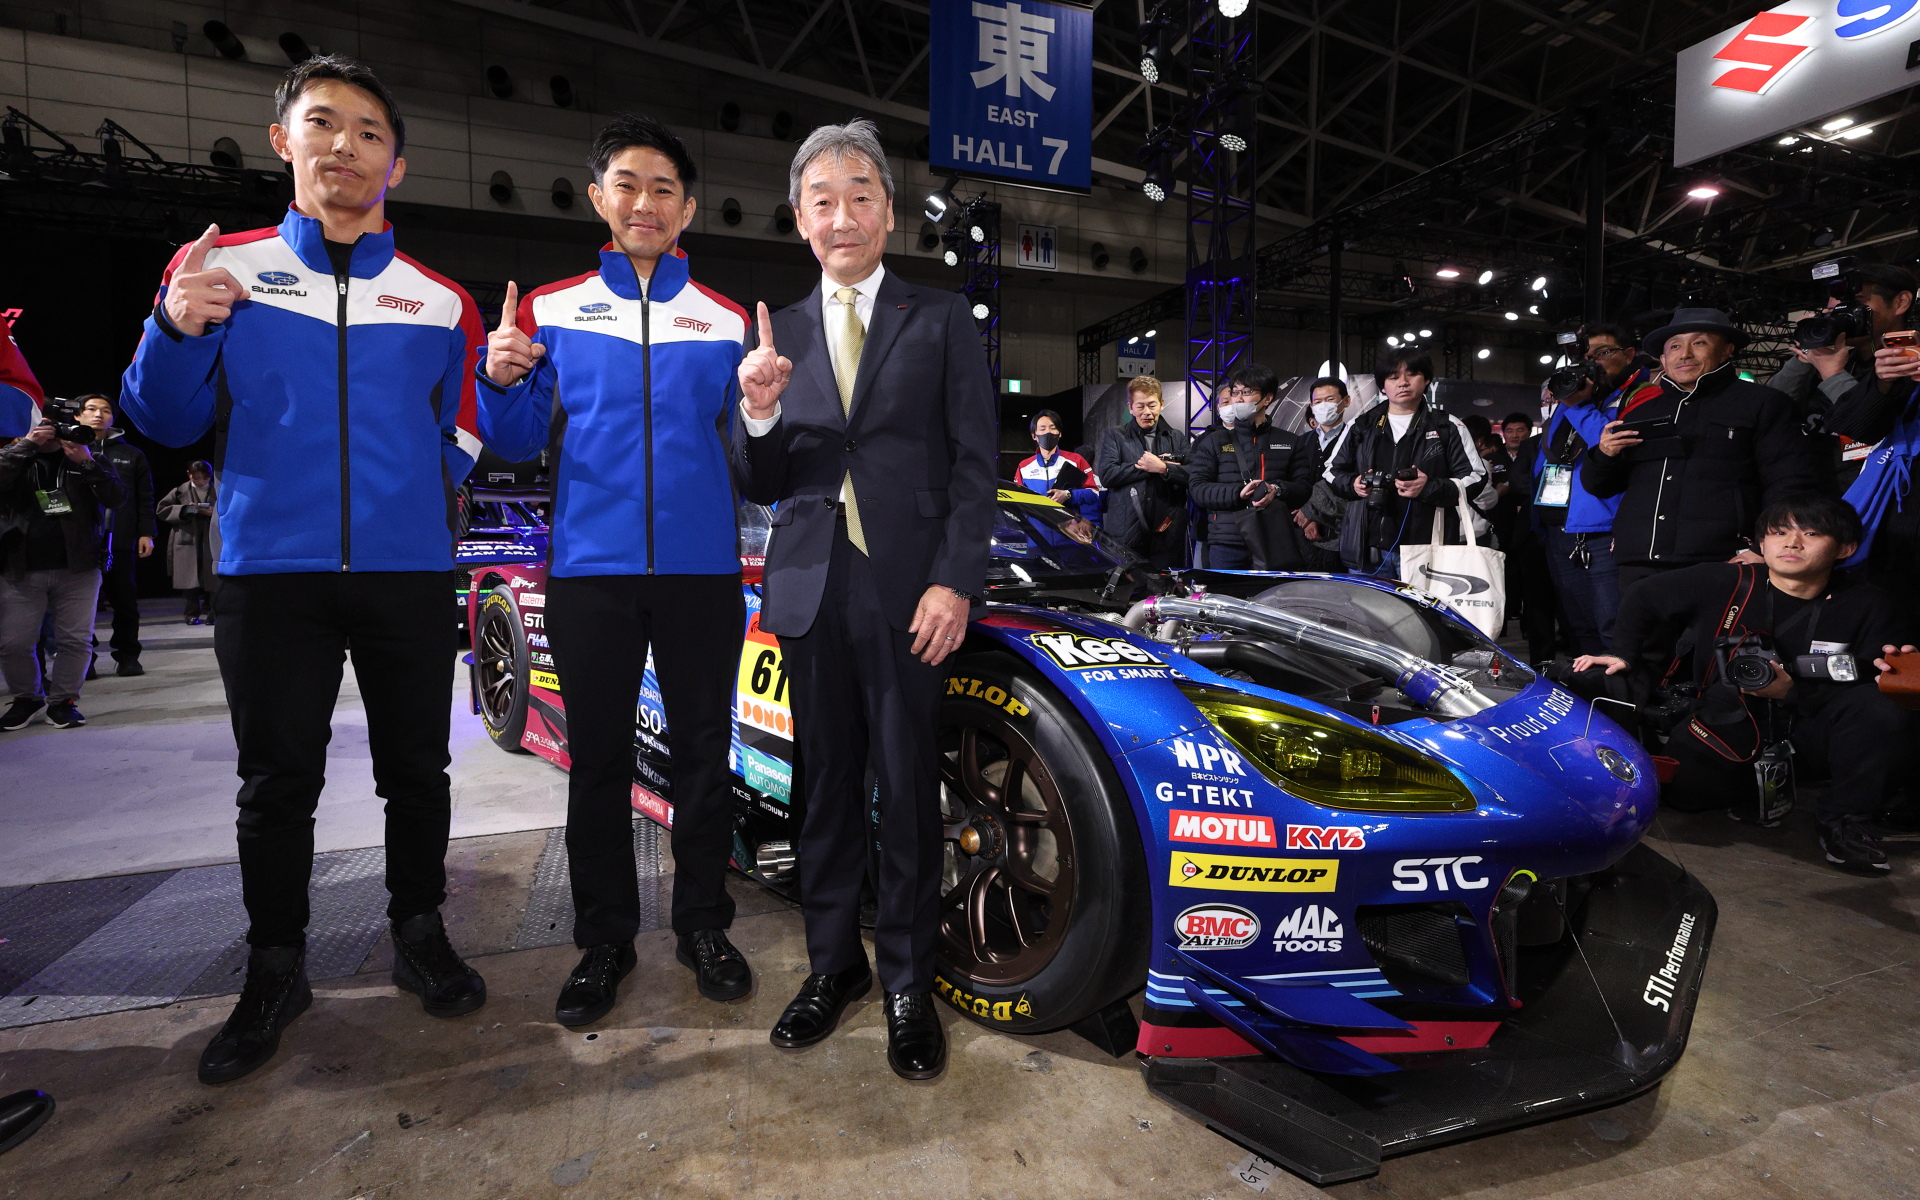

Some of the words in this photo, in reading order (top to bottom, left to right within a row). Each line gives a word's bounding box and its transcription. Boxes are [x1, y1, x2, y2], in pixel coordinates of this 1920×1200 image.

[970, 1, 1056, 102] 東
[987, 104, 1038, 128] EAST
[953, 134, 1032, 171] HALL
[1042, 136, 1068, 175] 7
[251, 285, 307, 297] SUBARU
[1123, 347, 1140, 355] HALL
[1142, 343, 1150, 355] 7
[485, 594, 511, 613] DUNLOP
[1465, 600, 1494, 608] TEIN
[1723, 605, 1739, 629] Canon
[751, 649, 789, 702] 61
[1081, 670, 1118, 683] FOR
[1122, 669, 1168, 679] SMART
[945, 677, 1030, 716] NLOP
[1543, 688, 1574, 717] BOXER
[1538, 706, 1561, 725] of
[1488, 714, 1548, 744] Proud
[1173, 739, 1247, 777] NPR
[1191, 772, 1239, 784] 日本ピストンリング
[1156, 782, 1254, 808] G-TEKT
[759, 800, 783, 818] IRIDIUM
[1173, 815, 1271, 842] MOTUL
[1286, 824, 1365, 850] KYB
[1205, 865, 1328, 883] DUNLOP
[1392, 855, 1489, 891] STC
[1185, 915, 1251, 938] BMC
[1273, 905, 1343, 938] MAC
[1184, 936, 1216, 946] Air
[1216, 936, 1243, 946] Filter
[1273, 940, 1342, 952] TOOLS
[1643, 974, 1675, 1013] STI
[1659, 912, 1695, 982] Performance
